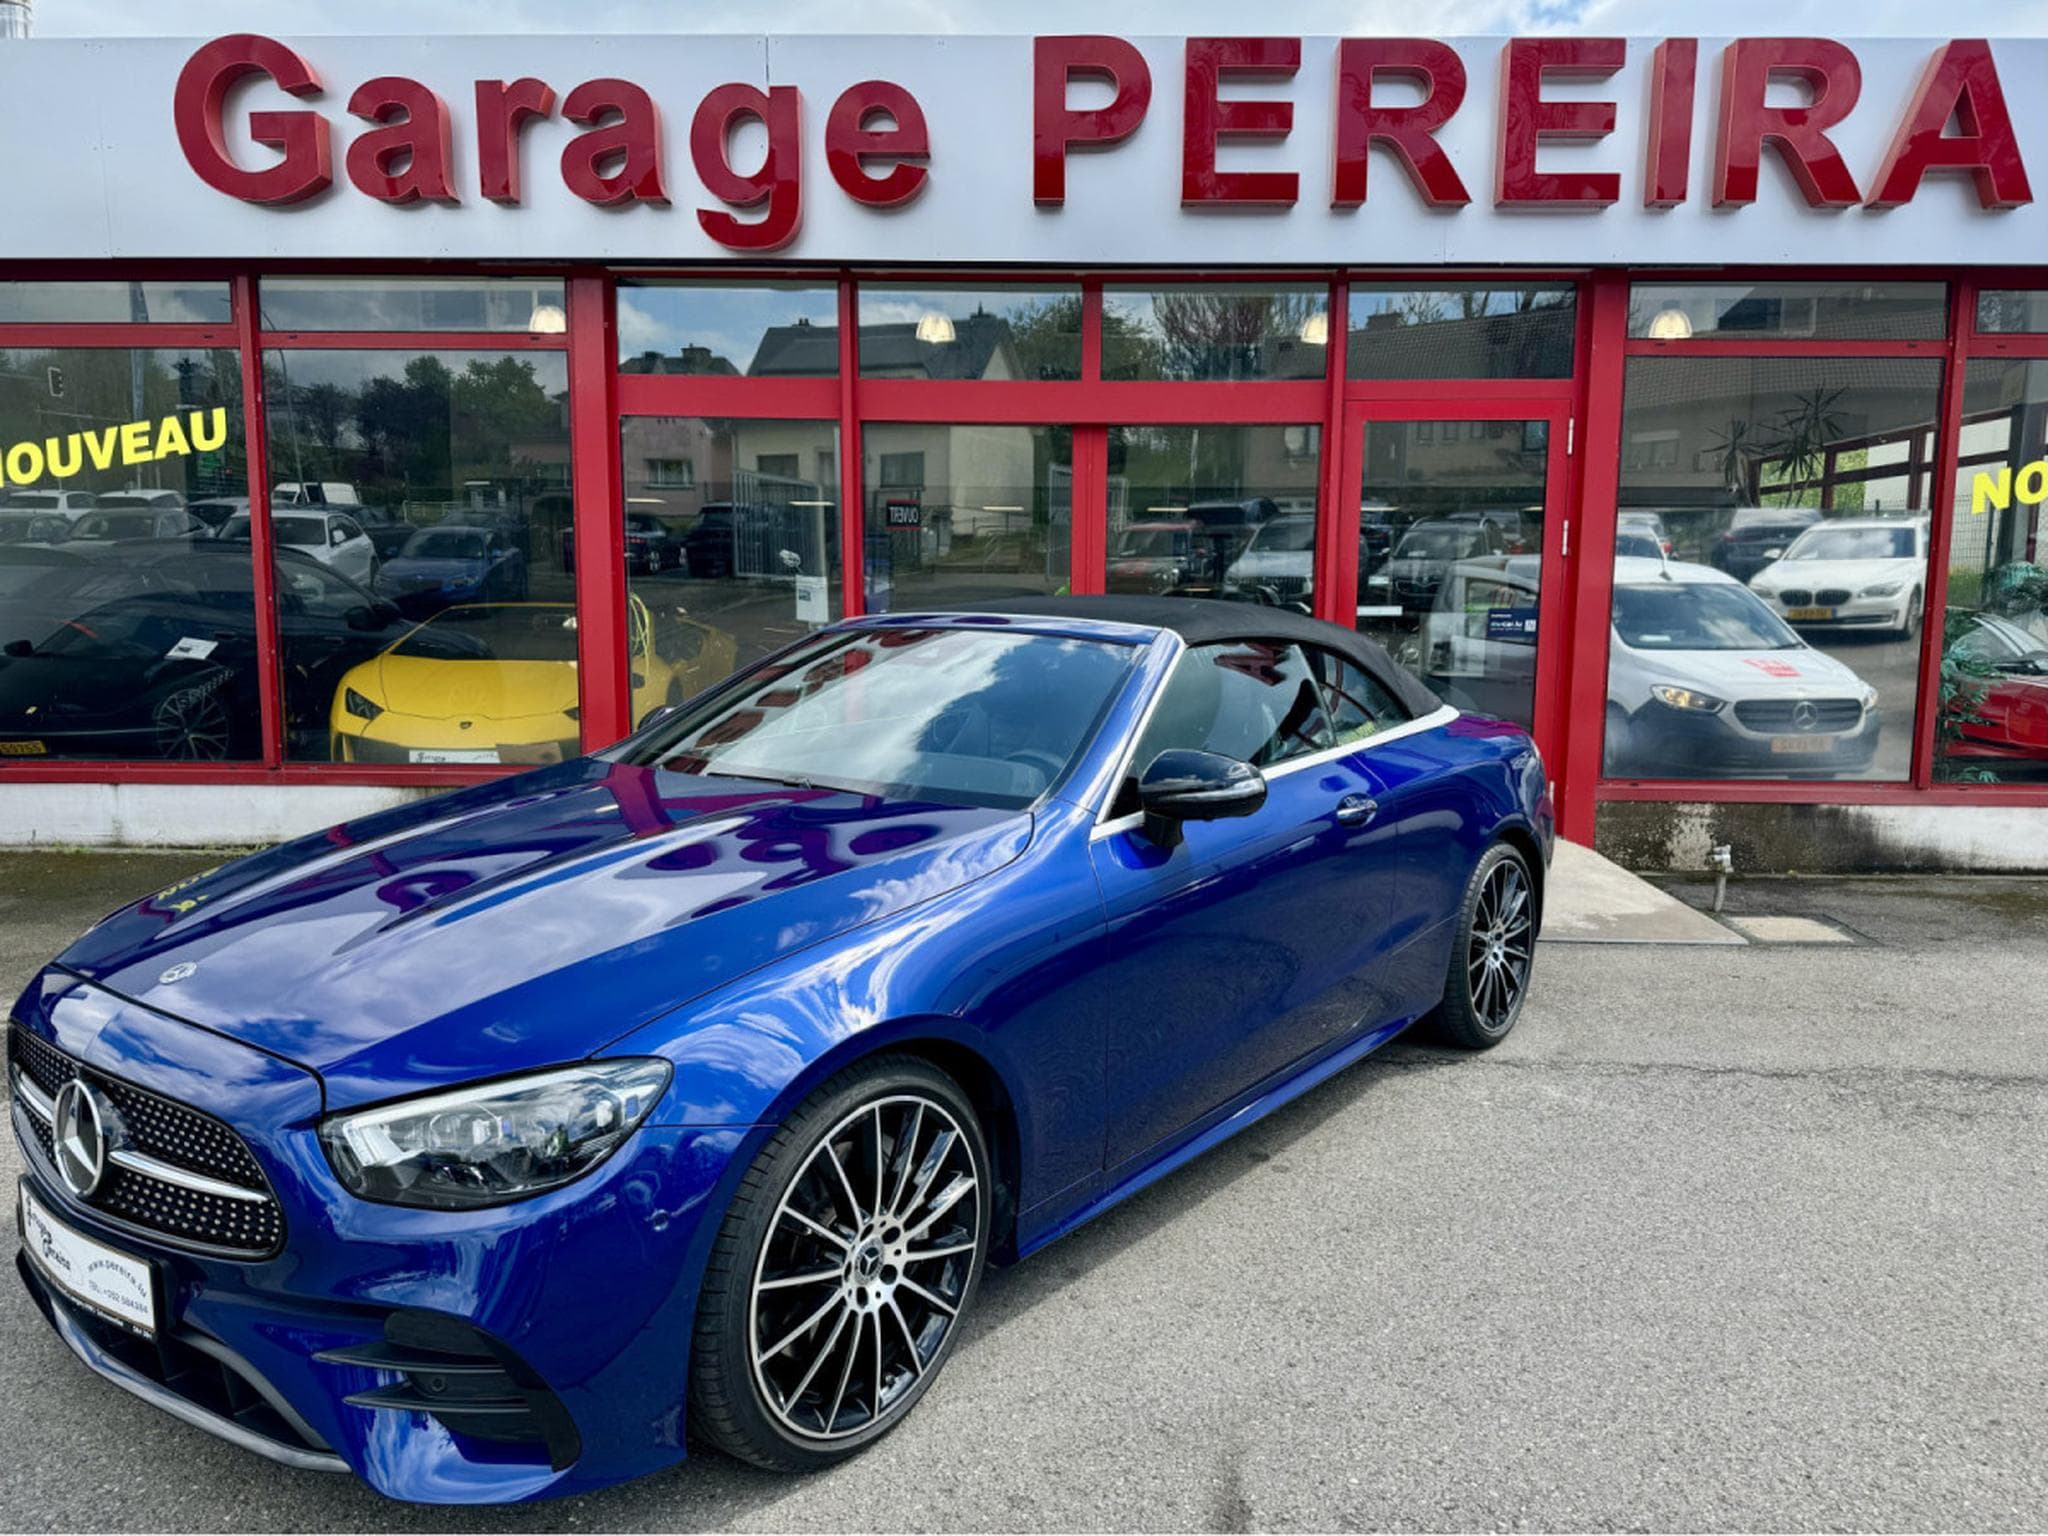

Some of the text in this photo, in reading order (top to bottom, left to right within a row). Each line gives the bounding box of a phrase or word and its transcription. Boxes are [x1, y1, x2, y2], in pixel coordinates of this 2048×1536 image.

[173, 33, 2035, 252] Garage PEREIRA
[0, 407, 227, 488] OUVEAU
